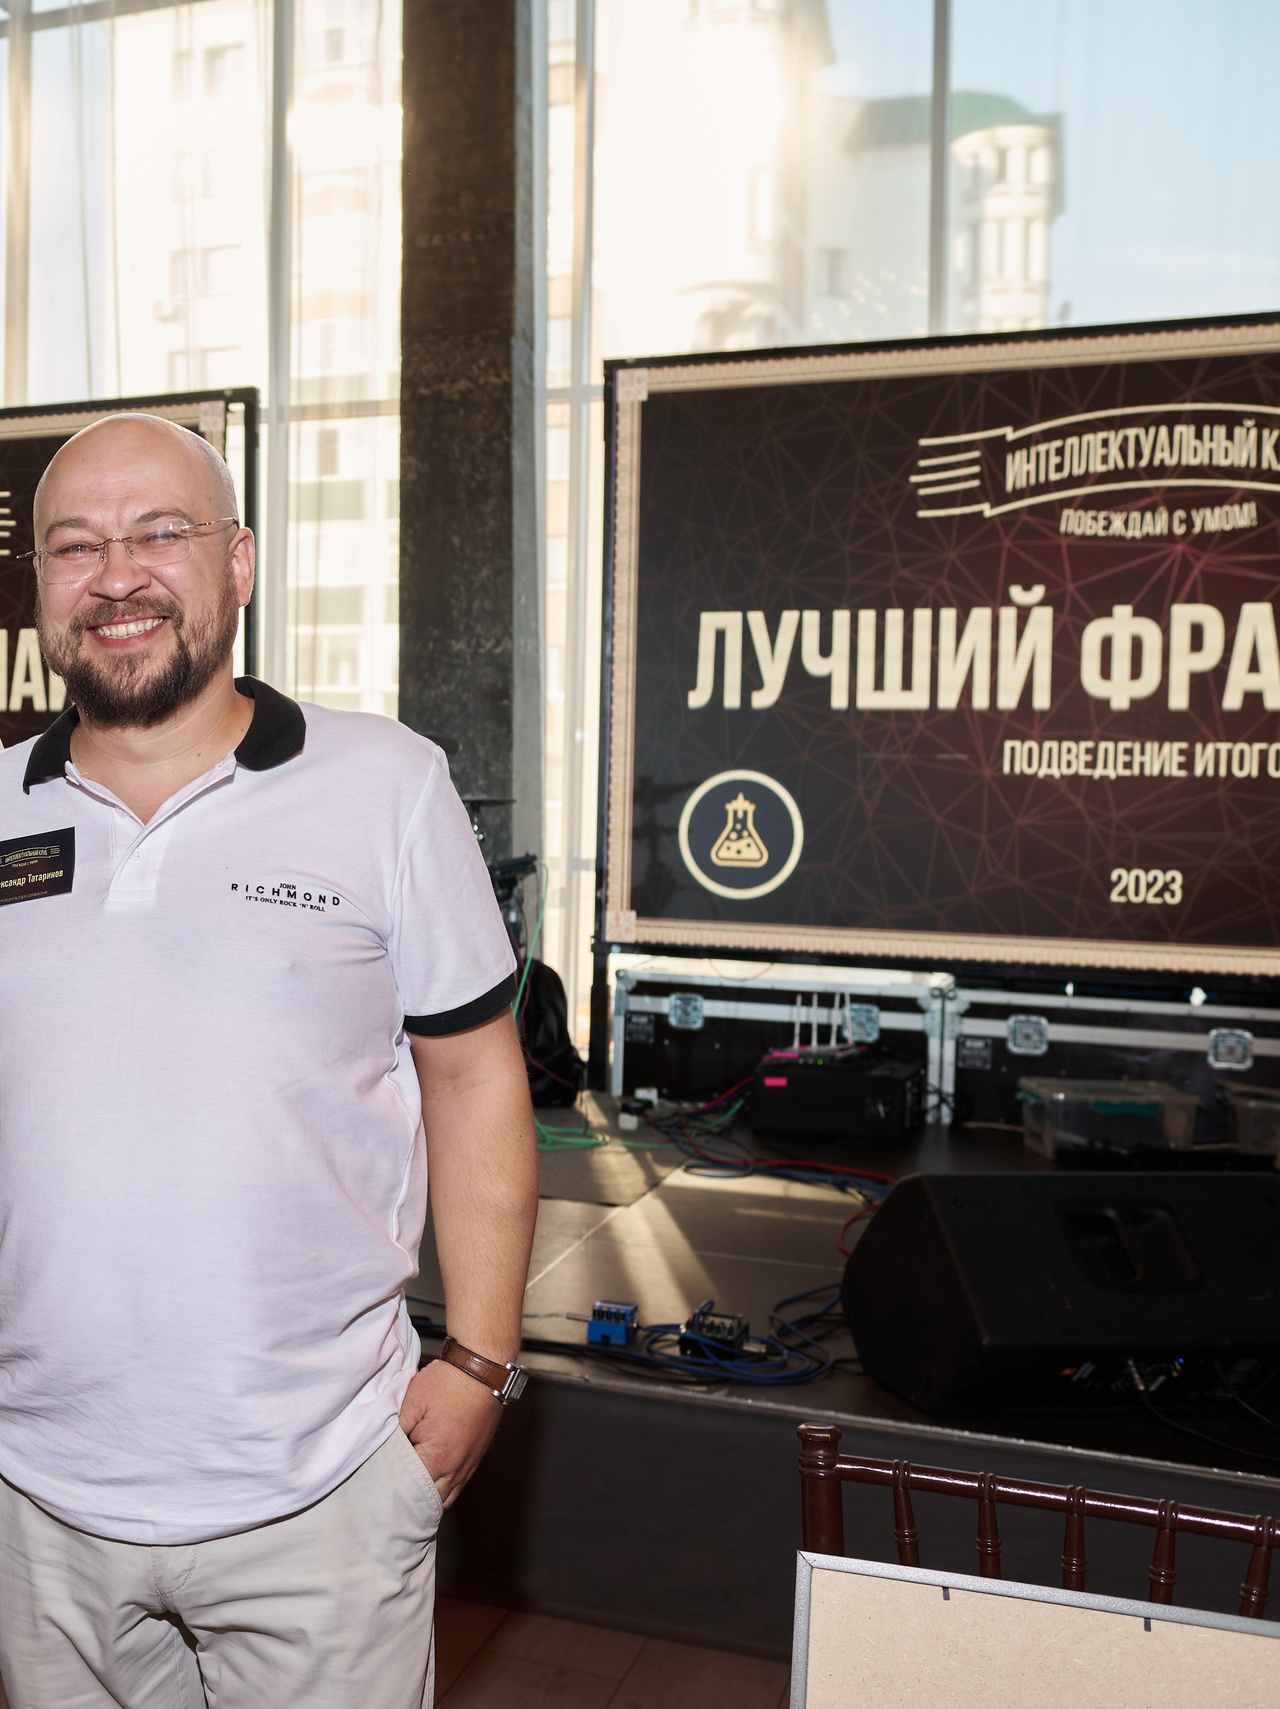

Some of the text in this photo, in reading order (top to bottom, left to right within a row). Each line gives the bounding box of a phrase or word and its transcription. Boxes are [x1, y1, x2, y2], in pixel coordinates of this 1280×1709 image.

[1005, 418, 1258, 493] ИНТЕЛЛЕКТУАЛЬНЫЙ
[1059, 501, 1258, 540] ПОБЕЖДАЙ С УМОМ!
[687, 583, 1054, 711] ЛУЧШИЙ
[1002, 740, 1189, 780] ПОДВЕДЕНИЕ
[28, 869, 64, 883] Татаринов
[231, 883, 340, 906] RICHMOND
[1109, 868, 1183, 905] 2023
[279, 899, 297, 908] ROCK
[310, 904, 325, 912] ROLL
